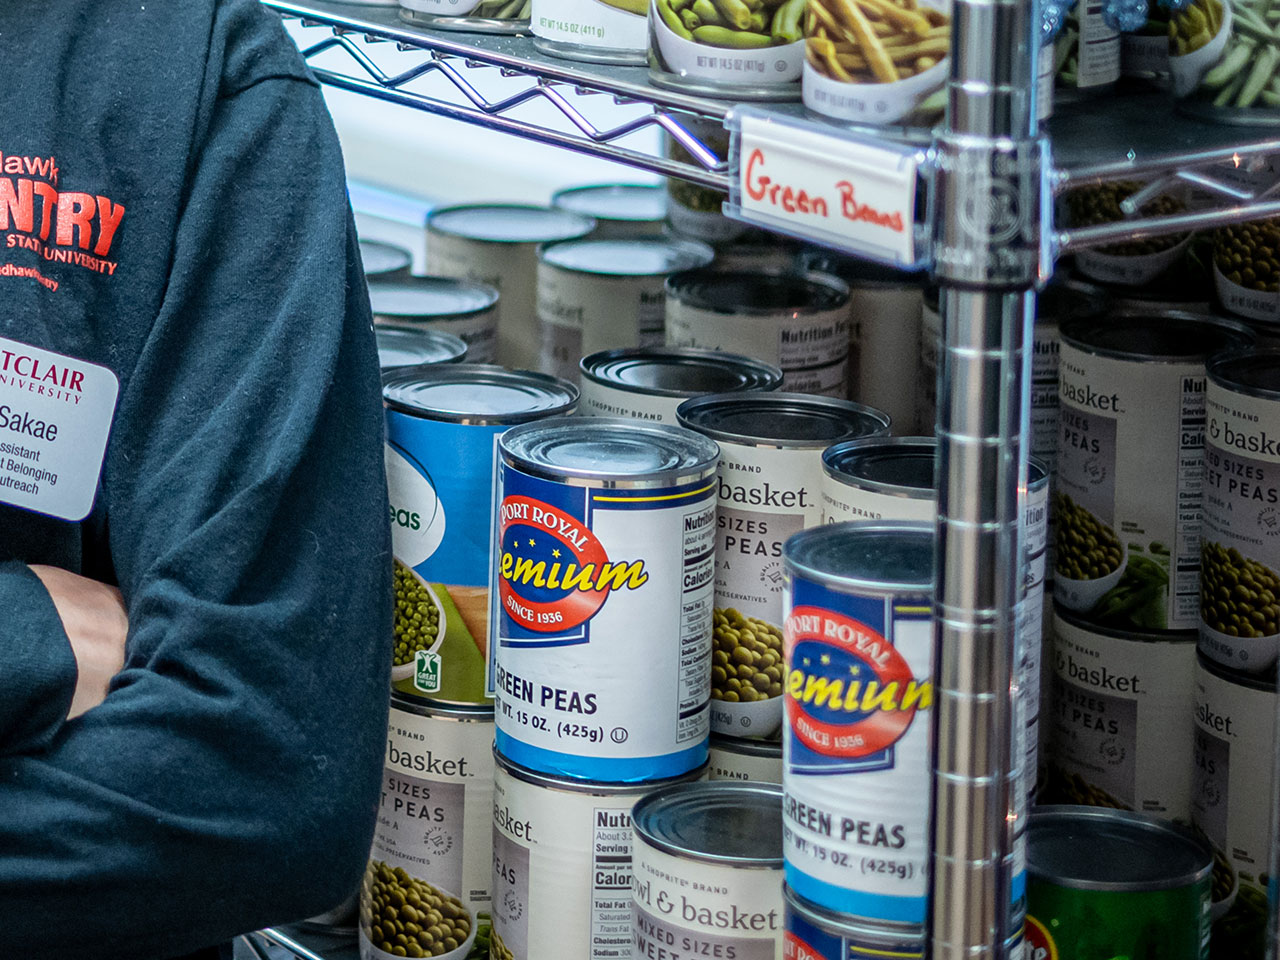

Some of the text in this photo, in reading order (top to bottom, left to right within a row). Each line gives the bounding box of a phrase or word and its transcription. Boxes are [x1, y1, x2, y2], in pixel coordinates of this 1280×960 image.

[556, 21, 579, 34] 14.5 OZ
[745, 148, 828, 217] Green
[44, 248, 118, 276] UNIVERSITY
[1061, 375, 1121, 413] basket
[631, 411, 664, 421] BRAND
[1231, 409, 1259, 422] BRAND
[1209, 419, 1220, 438] &
[1064, 429, 1100, 454] PEAS
[6, 459, 58, 487] Belonging
[729, 462, 762, 473] BRAND
[1224, 458, 1265, 481] SIZES
[717, 475, 808, 508] basket
[1228, 478, 1278, 503] PEAS
[852, 507, 882, 520] BRAND
[500, 503, 589, 553] PORT ROYAL
[717, 515, 768, 536] SIZES
[725, 535, 783, 558] PEAS
[499, 550, 650, 592] emium
[723, 561, 731, 570] A
[507, 595, 564, 624] SINCE 1936
[824, 619, 890, 670] ROYAL
[417, 672, 437, 680] GREAT
[425, 679, 437, 688] YOU
[1068, 656, 1140, 694] basket
[540, 685, 598, 715] PEAS
[502, 704, 604, 743] WT. 15 OZ. (425g)
[796, 717, 830, 748] SINCE
[1072, 708, 1119, 735] PEAS
[396, 728, 425, 742] BRAND
[388, 740, 468, 778] basket
[715, 769, 749, 781] BRAND
[388, 778, 431, 800] SIZES
[394, 797, 445, 822] PEAS
[392, 821, 399, 831] A
[596, 831, 620, 841] About
[841, 817, 905, 849] PEAS
[595, 843, 628, 855] Serving
[812, 845, 827, 861] 15
[831, 850, 853, 868] OZ.
[861, 855, 914, 879] (425g)
[595, 872, 632, 886] Calor
[692, 881, 728, 895] BRAND
[595, 901, 626, 909] Total Fat
[657, 890, 778, 931] & basket
[599, 913, 631, 921] Saturated
[600, 925, 629, 933] Trans Fat
[637, 915, 736, 960] MIXED SIZES
[593, 948, 619, 957] Sodium
